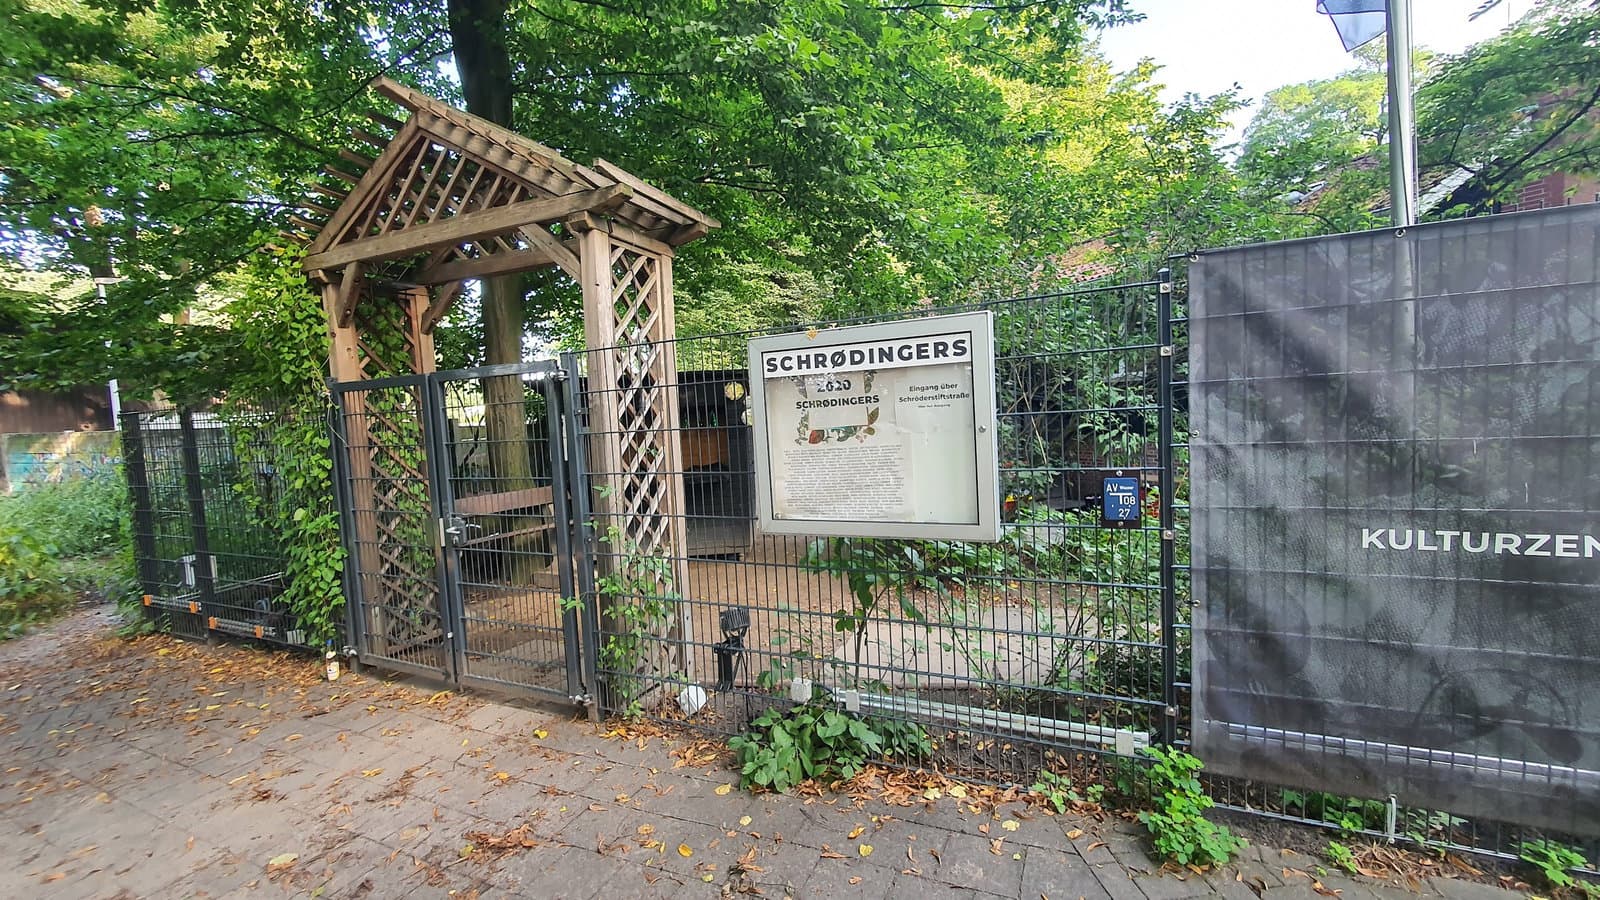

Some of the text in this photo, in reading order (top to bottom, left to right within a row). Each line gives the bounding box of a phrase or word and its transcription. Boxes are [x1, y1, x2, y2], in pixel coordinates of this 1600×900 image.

[766, 339, 968, 372] SCHRØDINGERS
[817, 379, 852, 393] 2020
[909, 383, 958, 393] Eingang über
[796, 395, 880, 410] SCHRØDINGERS
[898, 393, 970, 403] Schröderstiftstraße
[1106, 483, 1118, 492] AV
